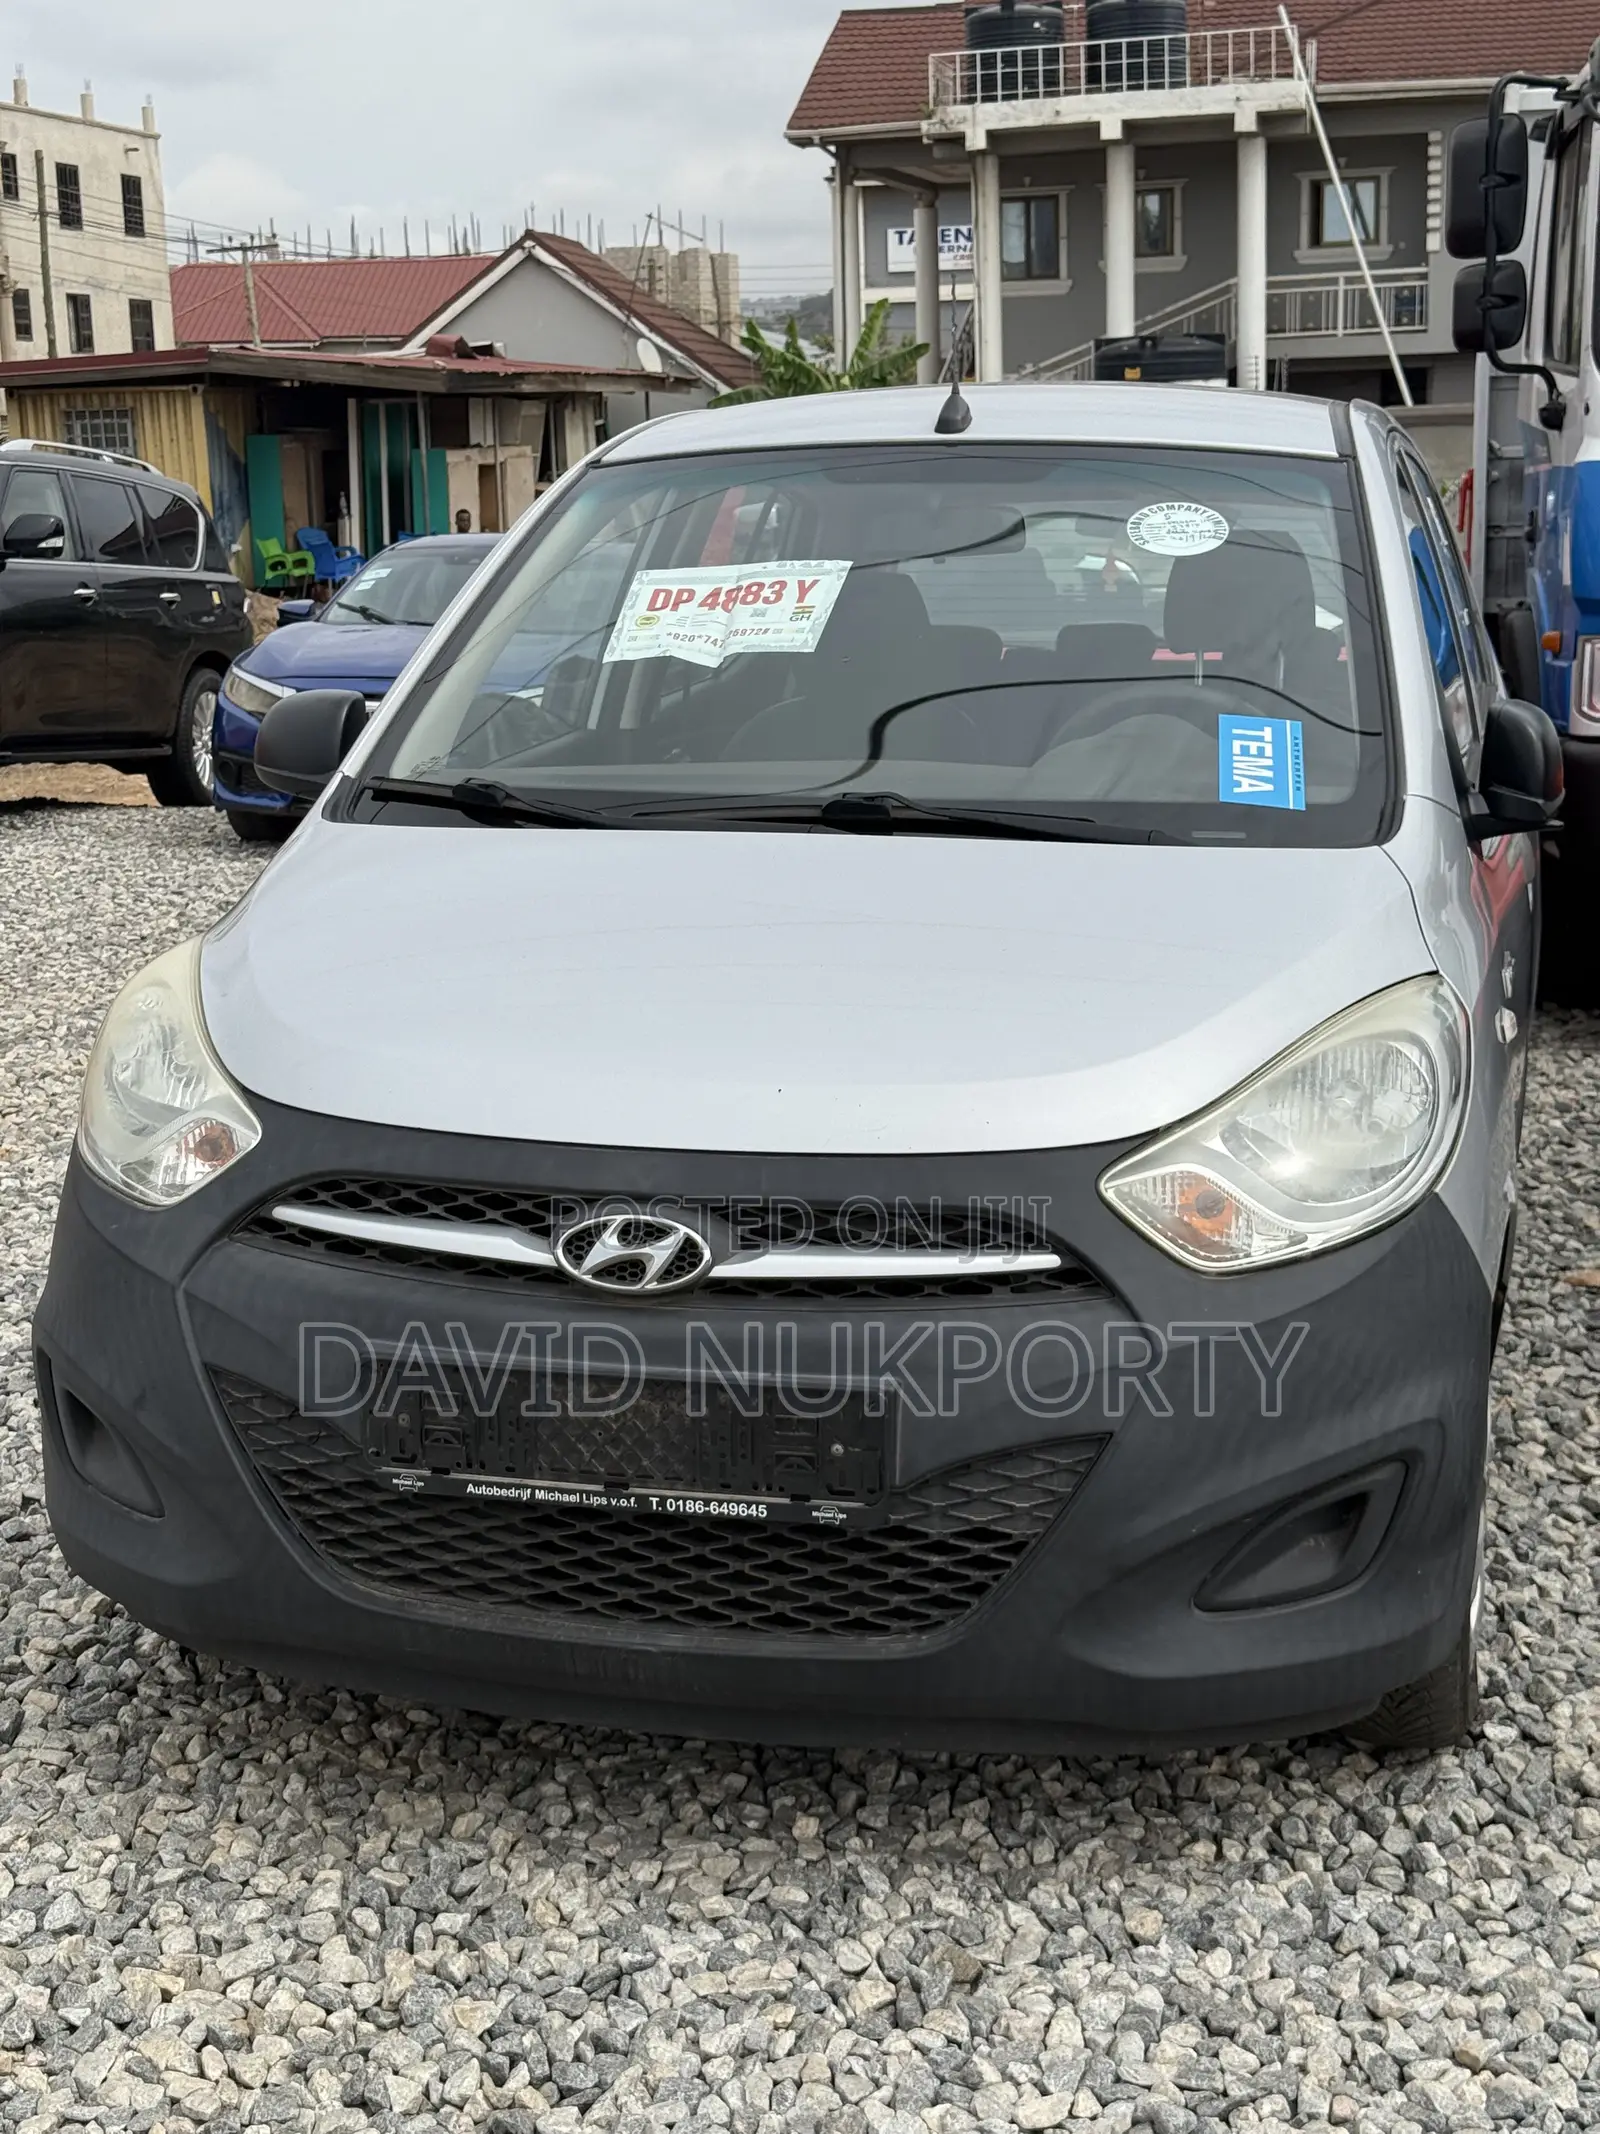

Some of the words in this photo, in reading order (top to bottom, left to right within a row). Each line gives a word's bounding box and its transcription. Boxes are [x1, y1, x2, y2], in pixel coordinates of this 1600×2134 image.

[1147, 503, 1210, 516] COMPANY
[1206, 513, 1227, 541] LIMITED
[646, 588, 696, 612] DP
[795, 579, 821, 604] Y
[789, 614, 811, 623] GH
[1232, 726, 1274, 793] TEMA
[466, 1483, 532, 1500] Autobedrijf
[535, 1489, 580, 1503] Michael
[582, 1493, 608, 1506] Lips
[610, 1496, 638, 1508] v.o.f.
[649, 1497, 662, 1511] T.
[666, 1498, 768, 1518] 0186-649645
